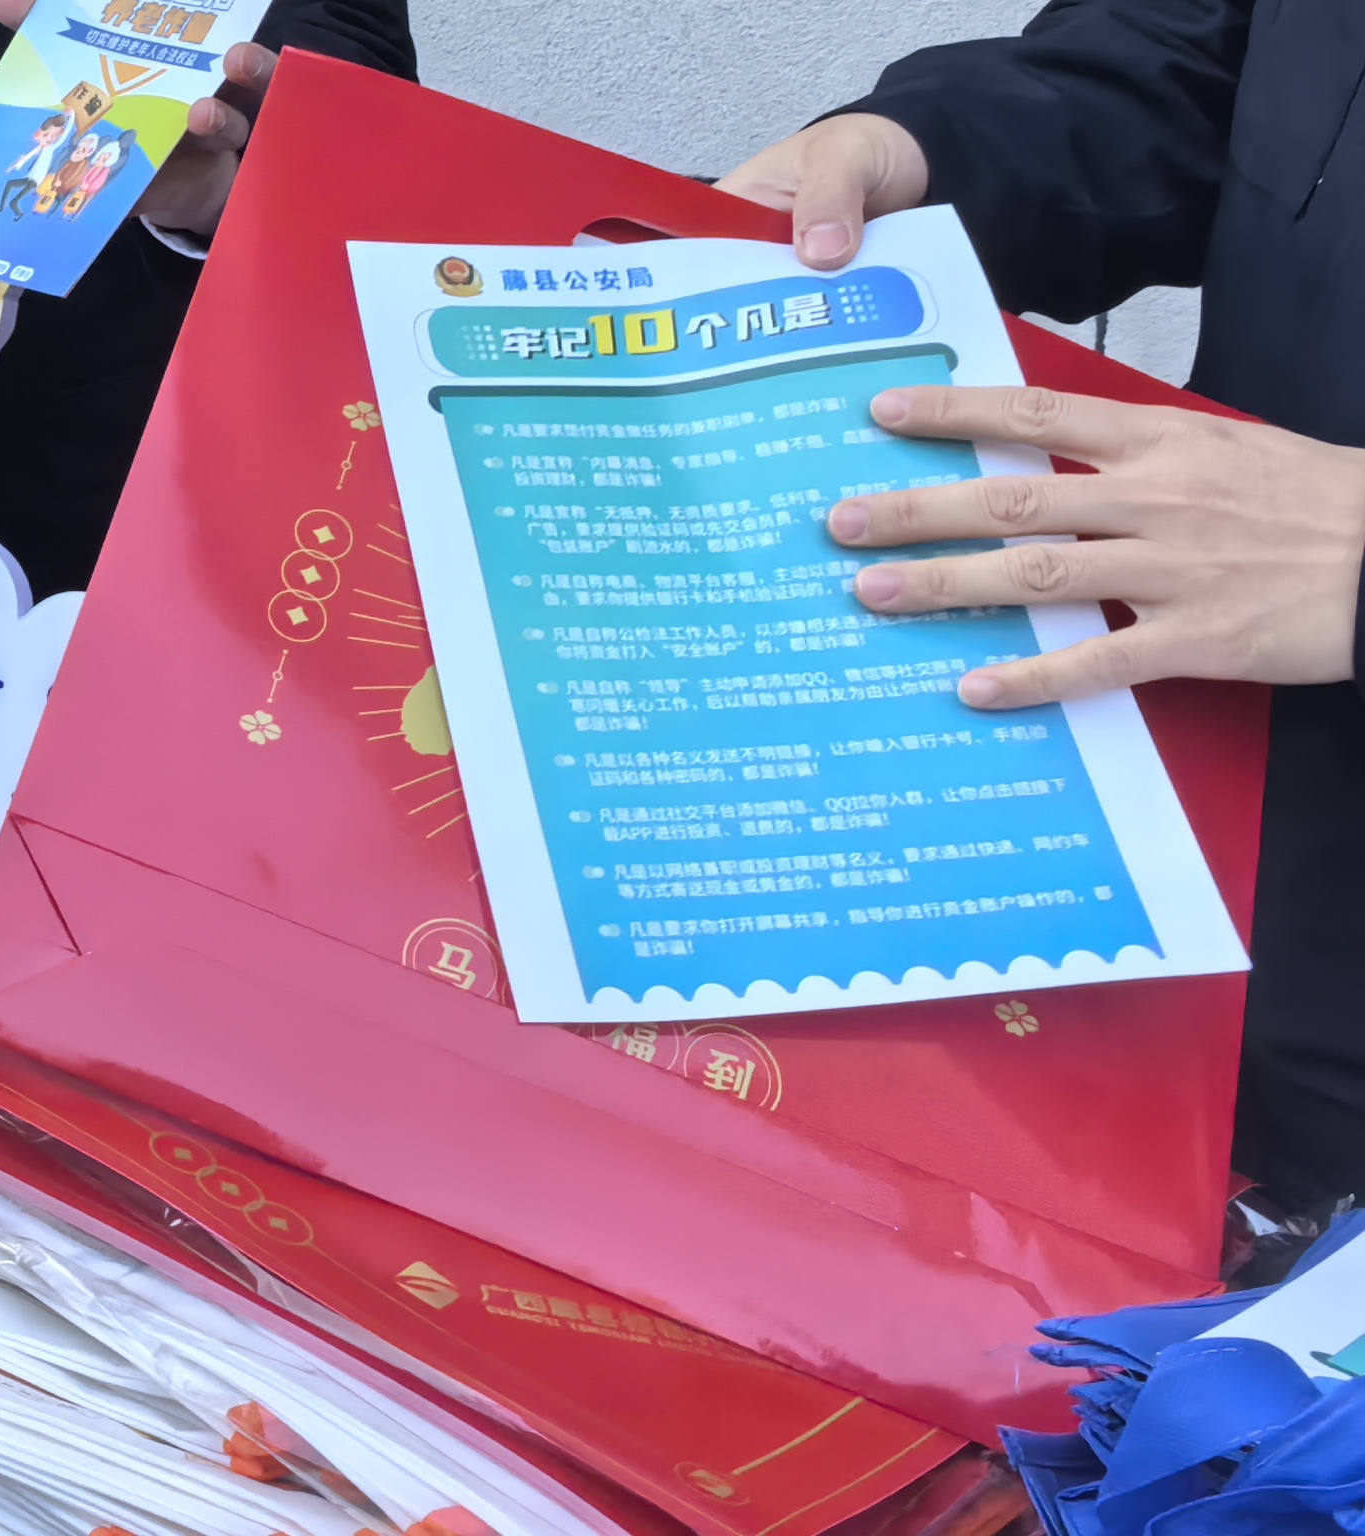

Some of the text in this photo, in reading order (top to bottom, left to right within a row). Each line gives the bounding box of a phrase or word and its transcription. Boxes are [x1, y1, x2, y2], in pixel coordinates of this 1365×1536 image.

[85, 29, 199, 66] 切实维护老年人合法权益
[500, 266, 654, 293] 藤县公安局
[500, 291, 832, 361] 牢记10个凡是
[426, 940, 477, 991] 马
[703, 1047, 757, 1102] 到
